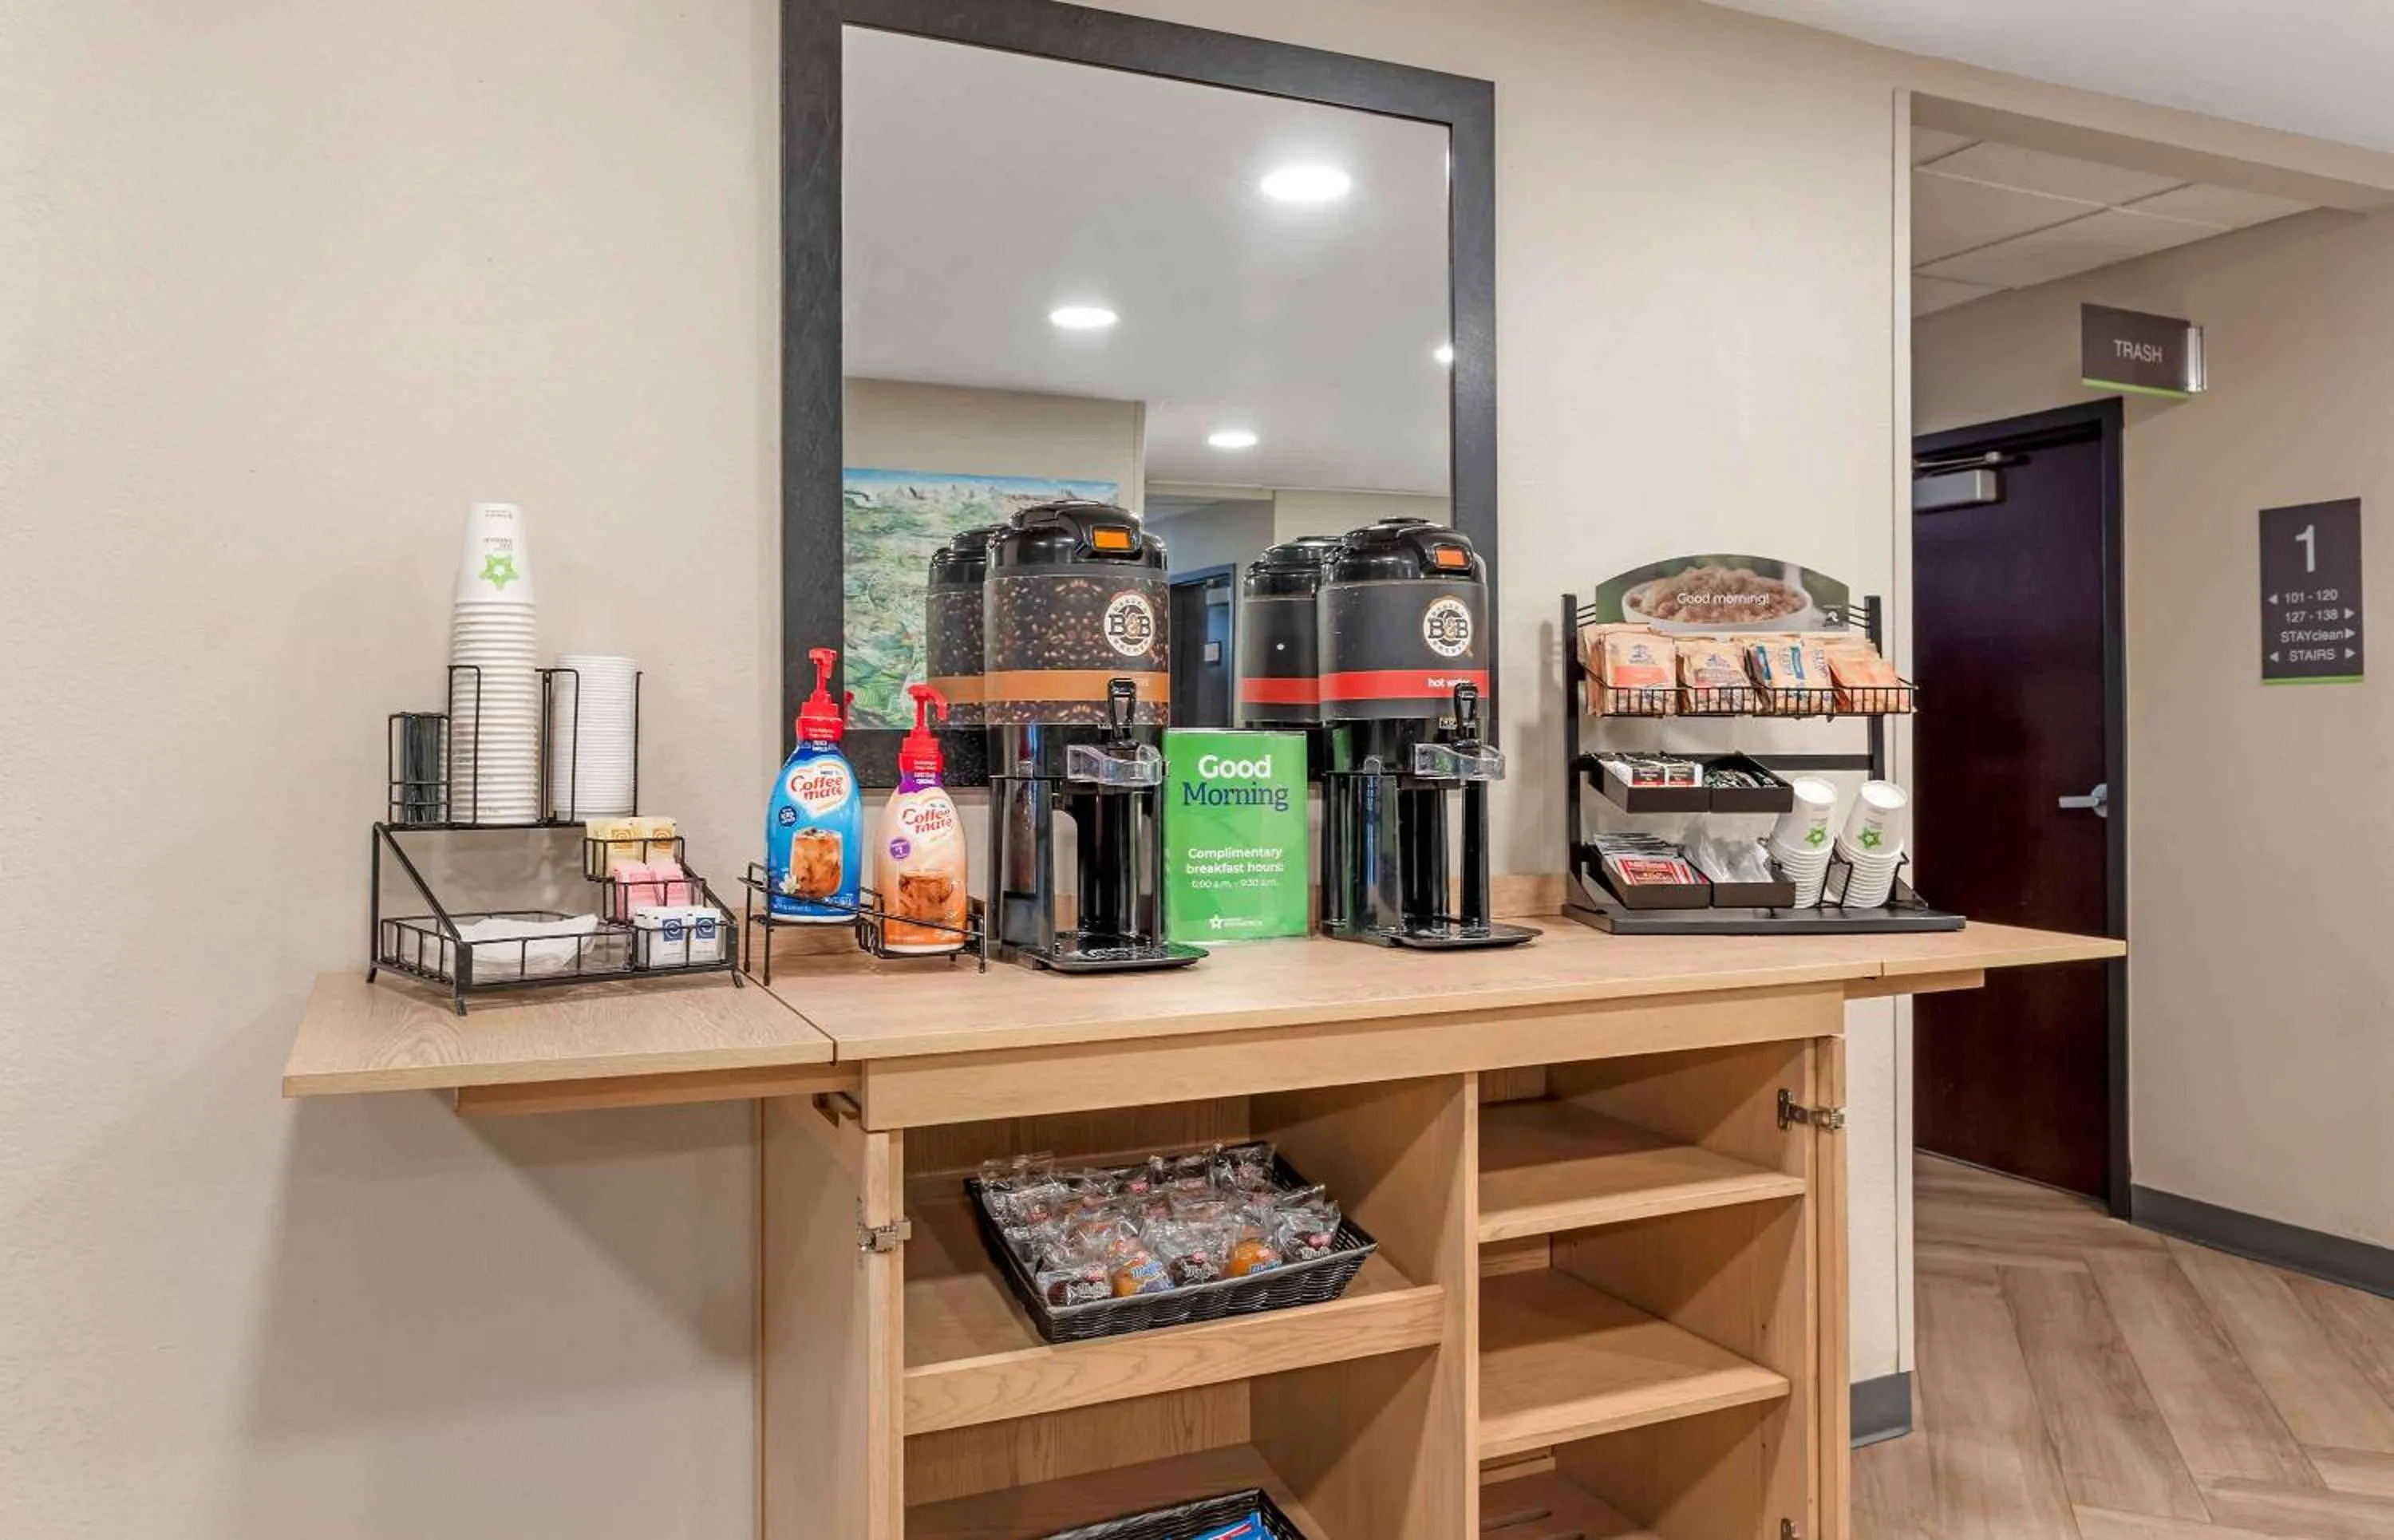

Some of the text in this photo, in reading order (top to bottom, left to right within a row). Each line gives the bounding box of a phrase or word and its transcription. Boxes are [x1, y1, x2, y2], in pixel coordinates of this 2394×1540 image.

[2113, 339, 2163, 363] TRASH
[2295, 524, 2316, 573] 1
[1677, 593, 1770, 606] Good morning!
[2285, 592, 2305, 604] 101
[2316, 589, 2338, 601] 120
[2285, 611, 2306, 623] 127
[2316, 609, 2338, 621] 138
[2280, 630, 2344, 643] STAYclean
[2289, 648, 2335, 661] STAIRS
[1428, 677, 1446, 687] hot
[1198, 754, 1271, 780] Good
[791, 775, 843, 792] Coffee
[804, 786, 843, 800] mate
[1183, 781, 1289, 811] Morning
[903, 808, 950, 825] Coffee
[915, 818, 953, 834] mate
[1187, 847, 1282, 860] Complimentary
[1186, 862, 1284, 875] breakfast hours:
